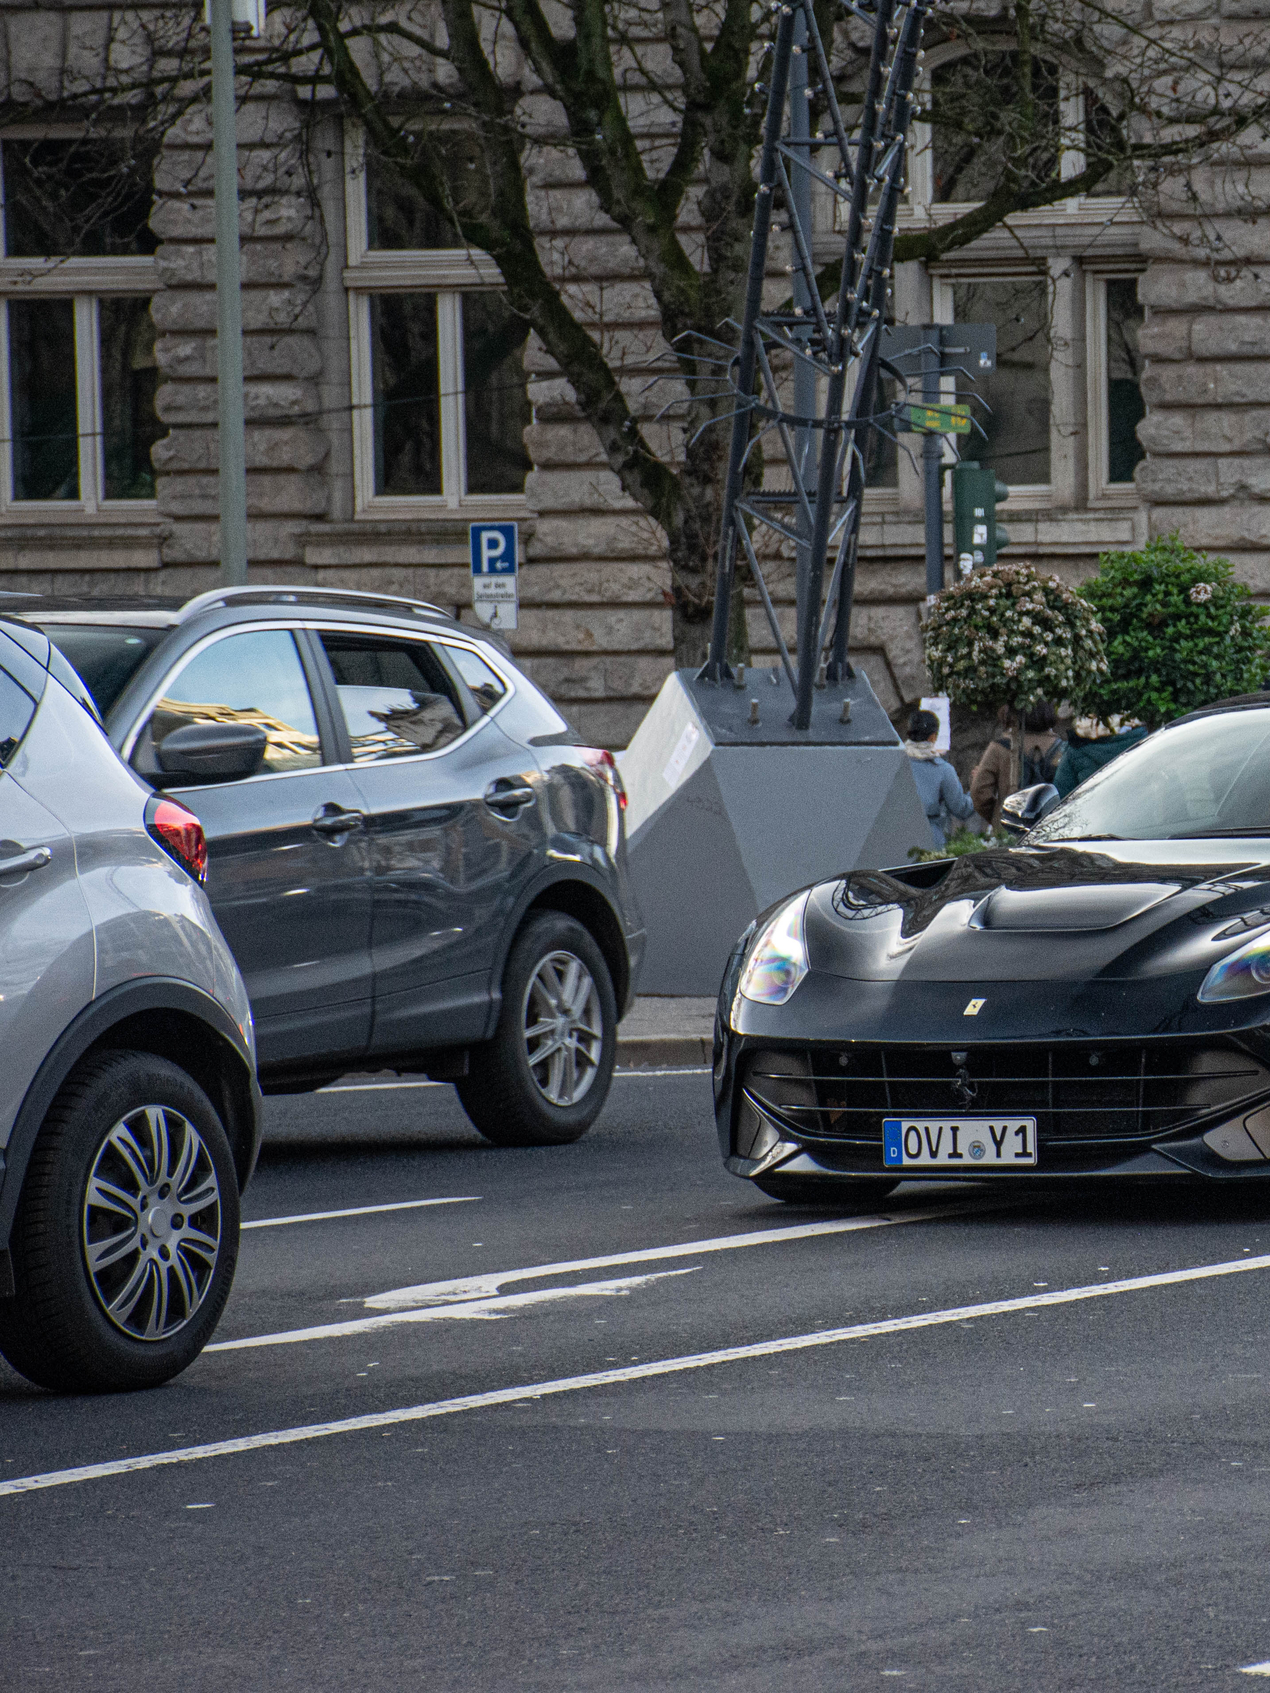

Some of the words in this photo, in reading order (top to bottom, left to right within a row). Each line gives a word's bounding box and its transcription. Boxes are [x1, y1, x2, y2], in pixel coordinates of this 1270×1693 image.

[481, 530, 507, 573] P
[890, 1147, 898, 1157] D
[904, 1125, 964, 1159] OVI
[988, 1124, 1033, 1158] Y1
